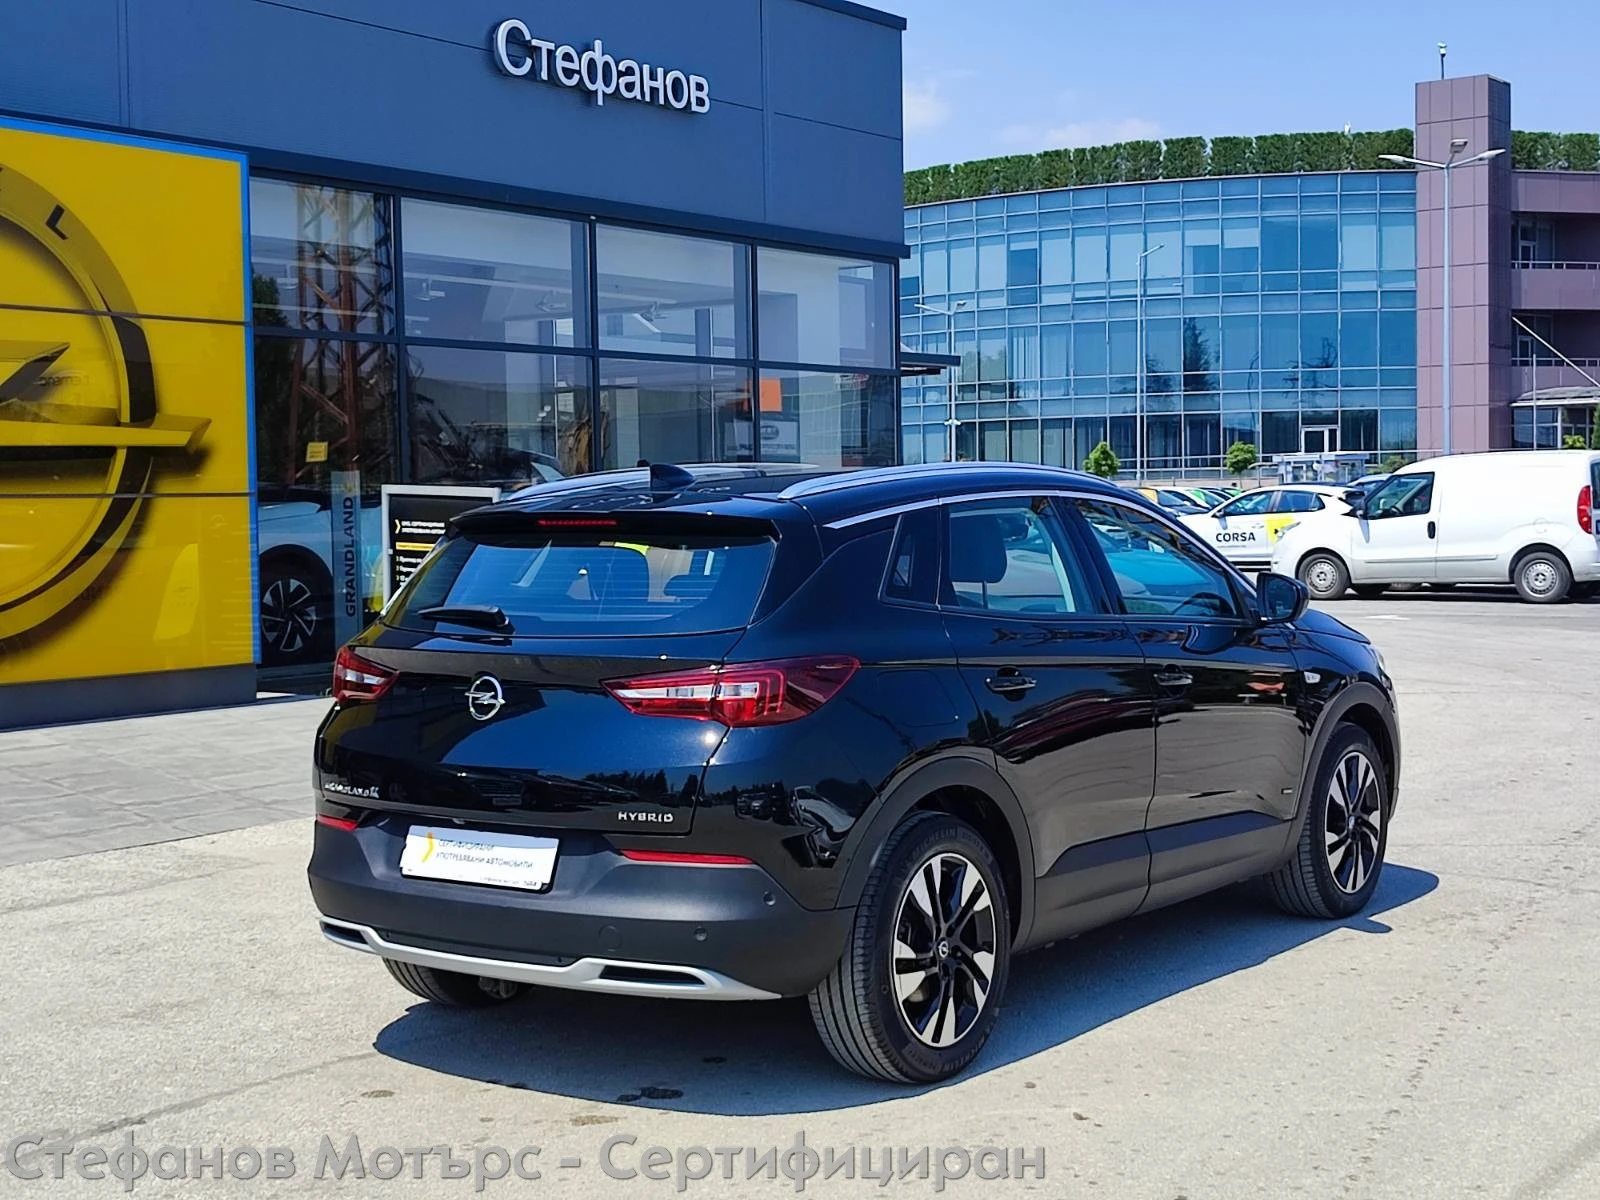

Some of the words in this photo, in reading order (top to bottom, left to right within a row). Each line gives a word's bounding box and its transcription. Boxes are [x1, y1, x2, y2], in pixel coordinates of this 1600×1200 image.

[495, 19, 711, 114] Стефанов
[343, 497, 356, 617] GRANDLAND
[1216, 532, 1256, 542] CORSA
[618, 811, 674, 822] HYBRID
